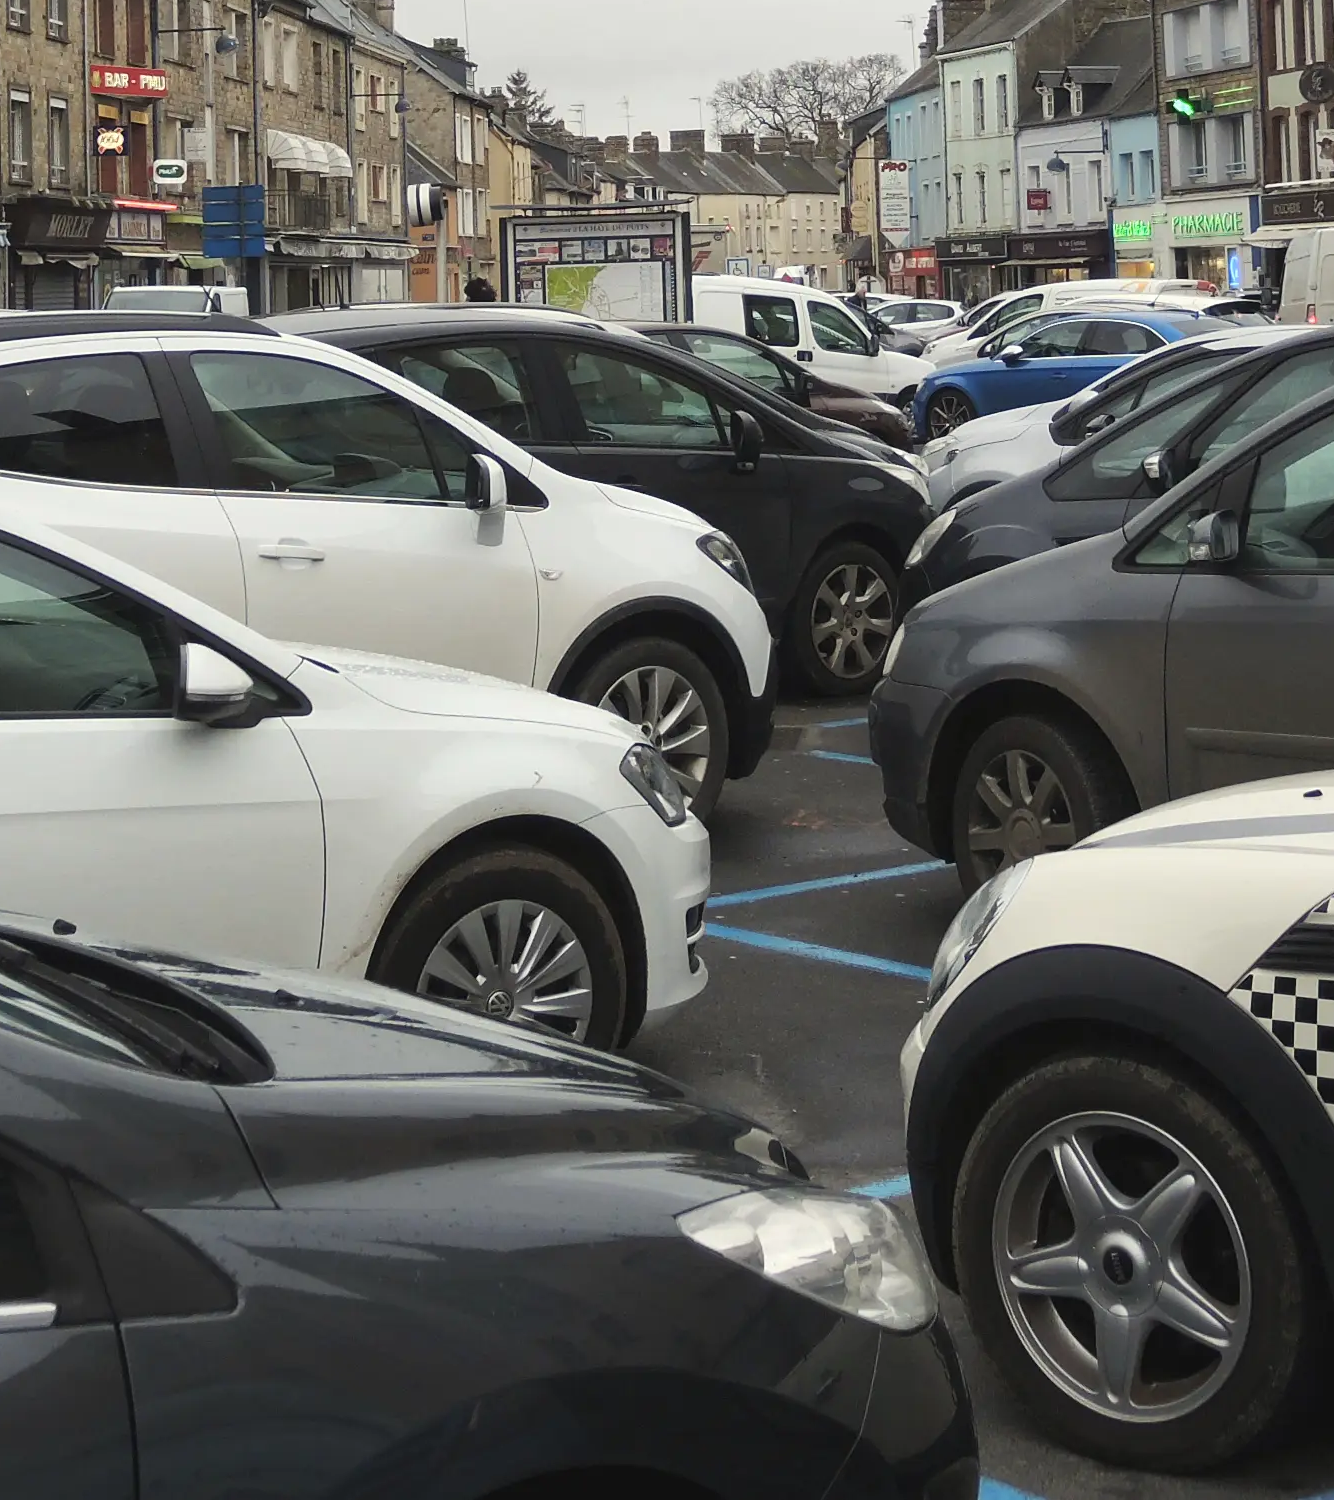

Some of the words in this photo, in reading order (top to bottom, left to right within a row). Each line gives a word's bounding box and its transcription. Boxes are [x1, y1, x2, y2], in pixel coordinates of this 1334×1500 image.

[104, 72, 129, 89] BAR
[139, 74, 166, 91] PMU
[46, 213, 95, 238] MORLET
[1172, 211, 1244, 235] PHARMACIE
